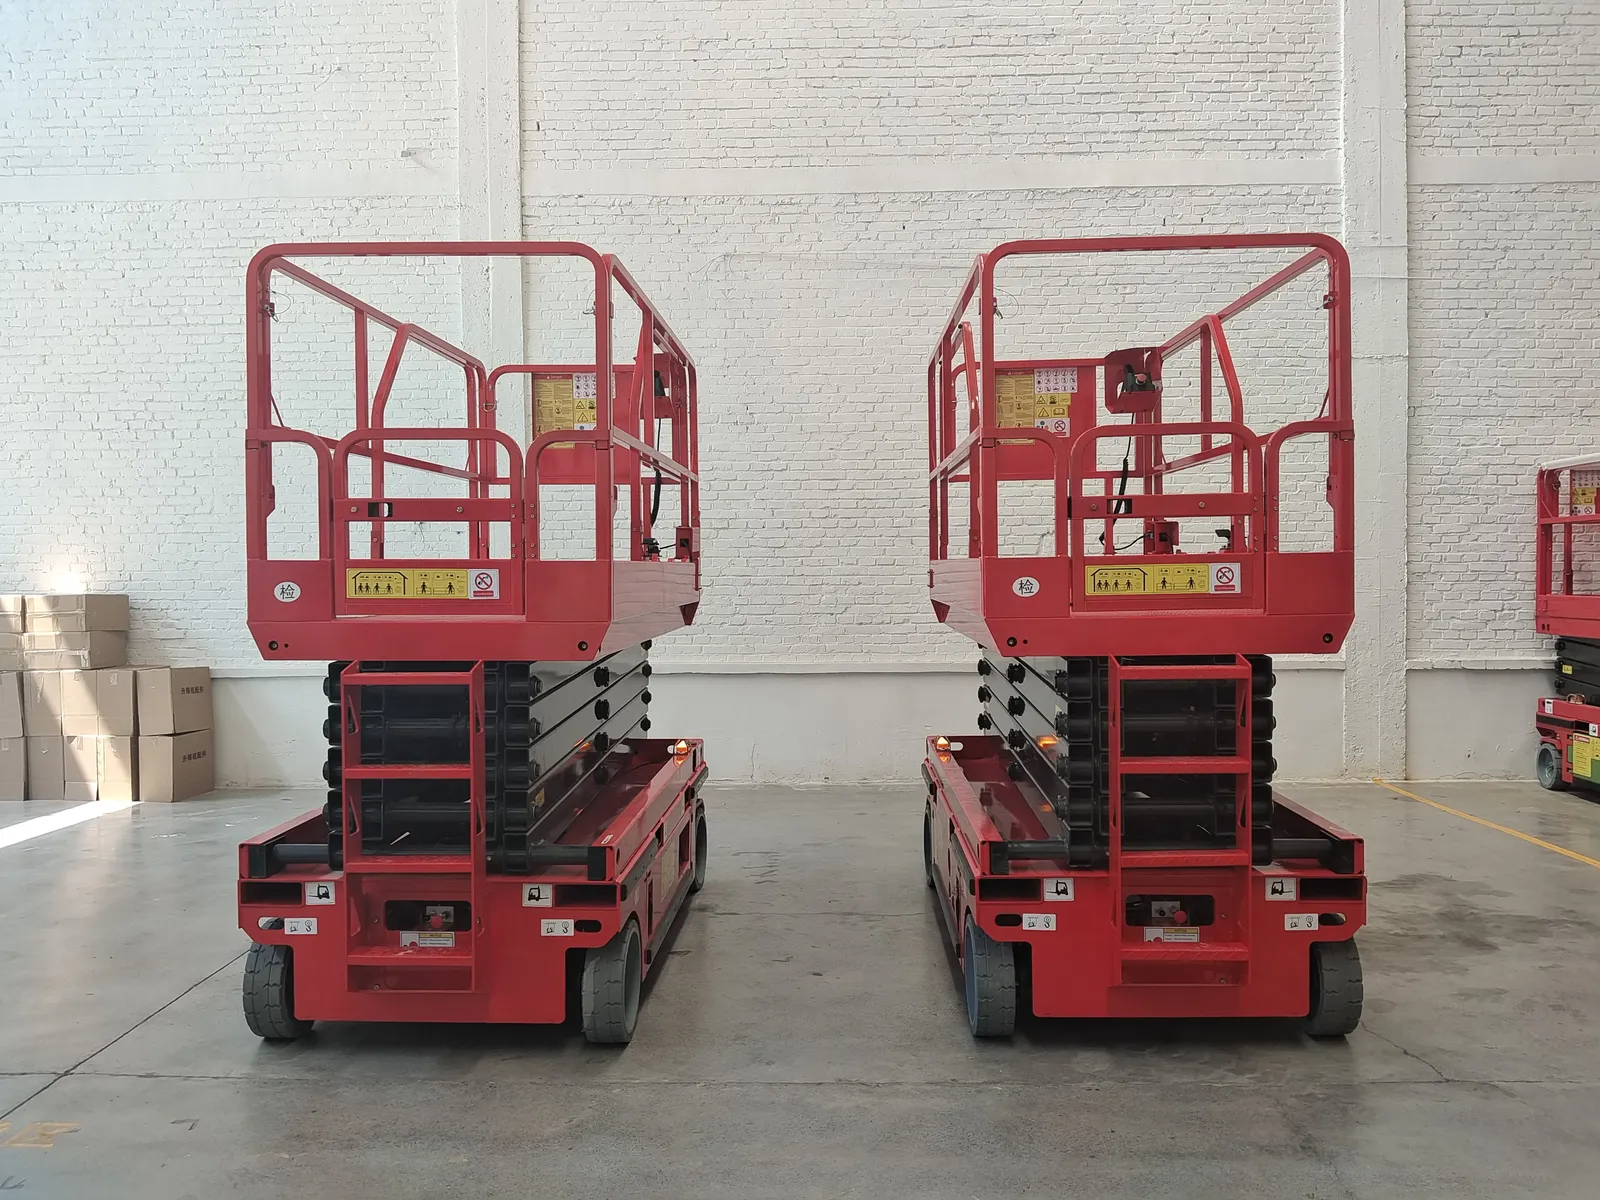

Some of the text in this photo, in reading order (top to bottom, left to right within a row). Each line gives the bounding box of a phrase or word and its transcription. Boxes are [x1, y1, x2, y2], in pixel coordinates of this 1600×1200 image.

[280, 584, 295, 600] 检
[1018, 579, 1034, 595] 检
[181, 686, 204, 695] 升降机配件
